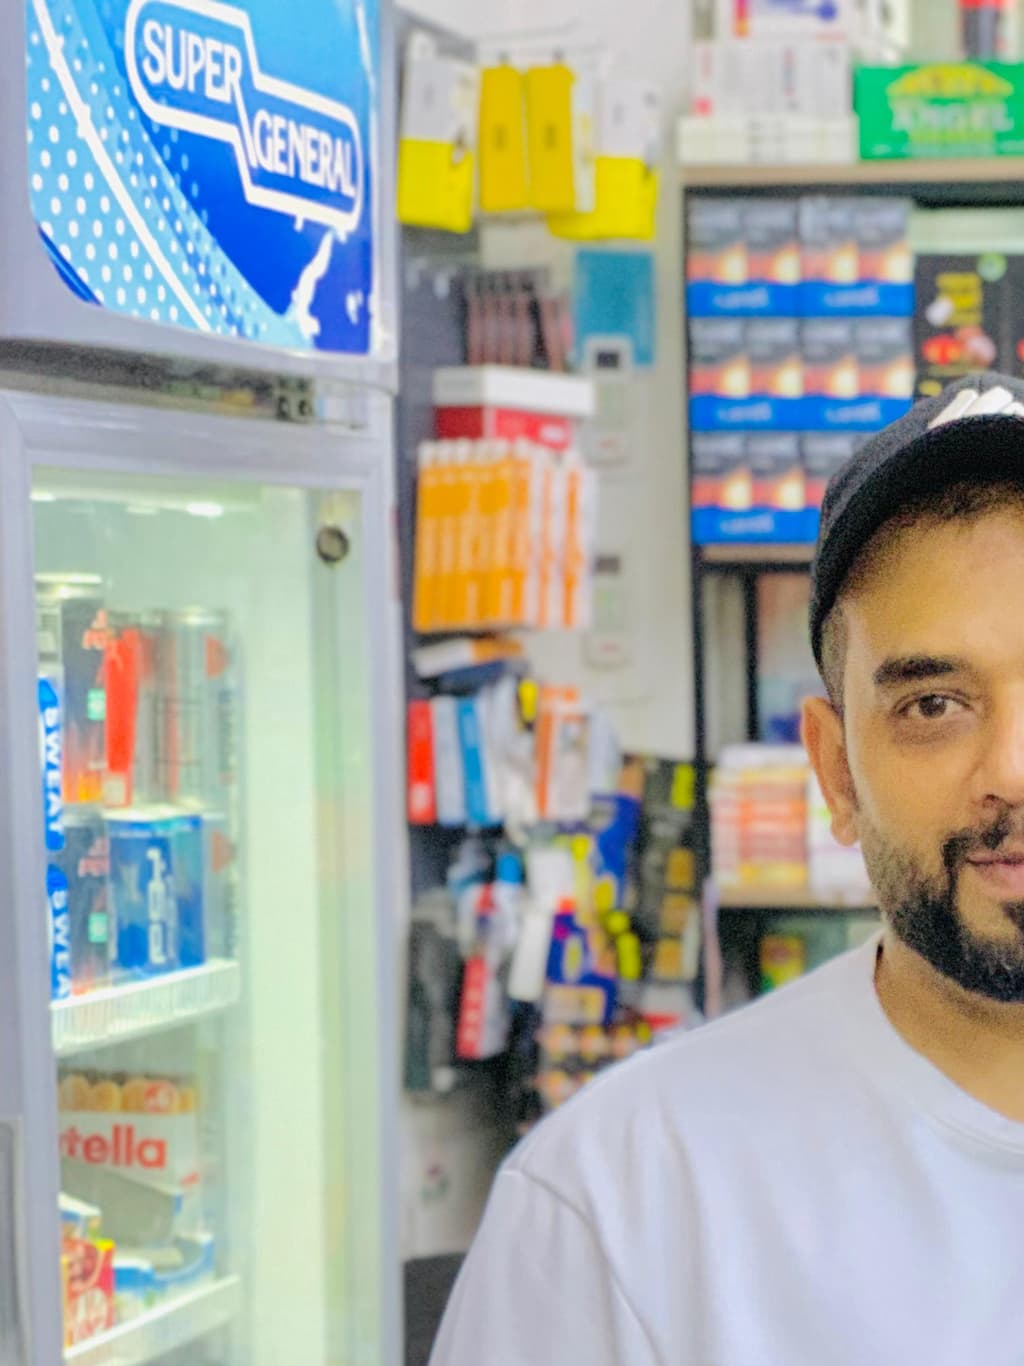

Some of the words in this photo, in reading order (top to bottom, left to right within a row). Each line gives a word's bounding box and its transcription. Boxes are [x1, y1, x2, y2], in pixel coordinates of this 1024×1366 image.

[142, 19, 242, 104] SUPER
[252, 108, 357, 199] GENERAL
[51, 889, 73, 999] SWEA
[60, 1123, 168, 1170] tella
